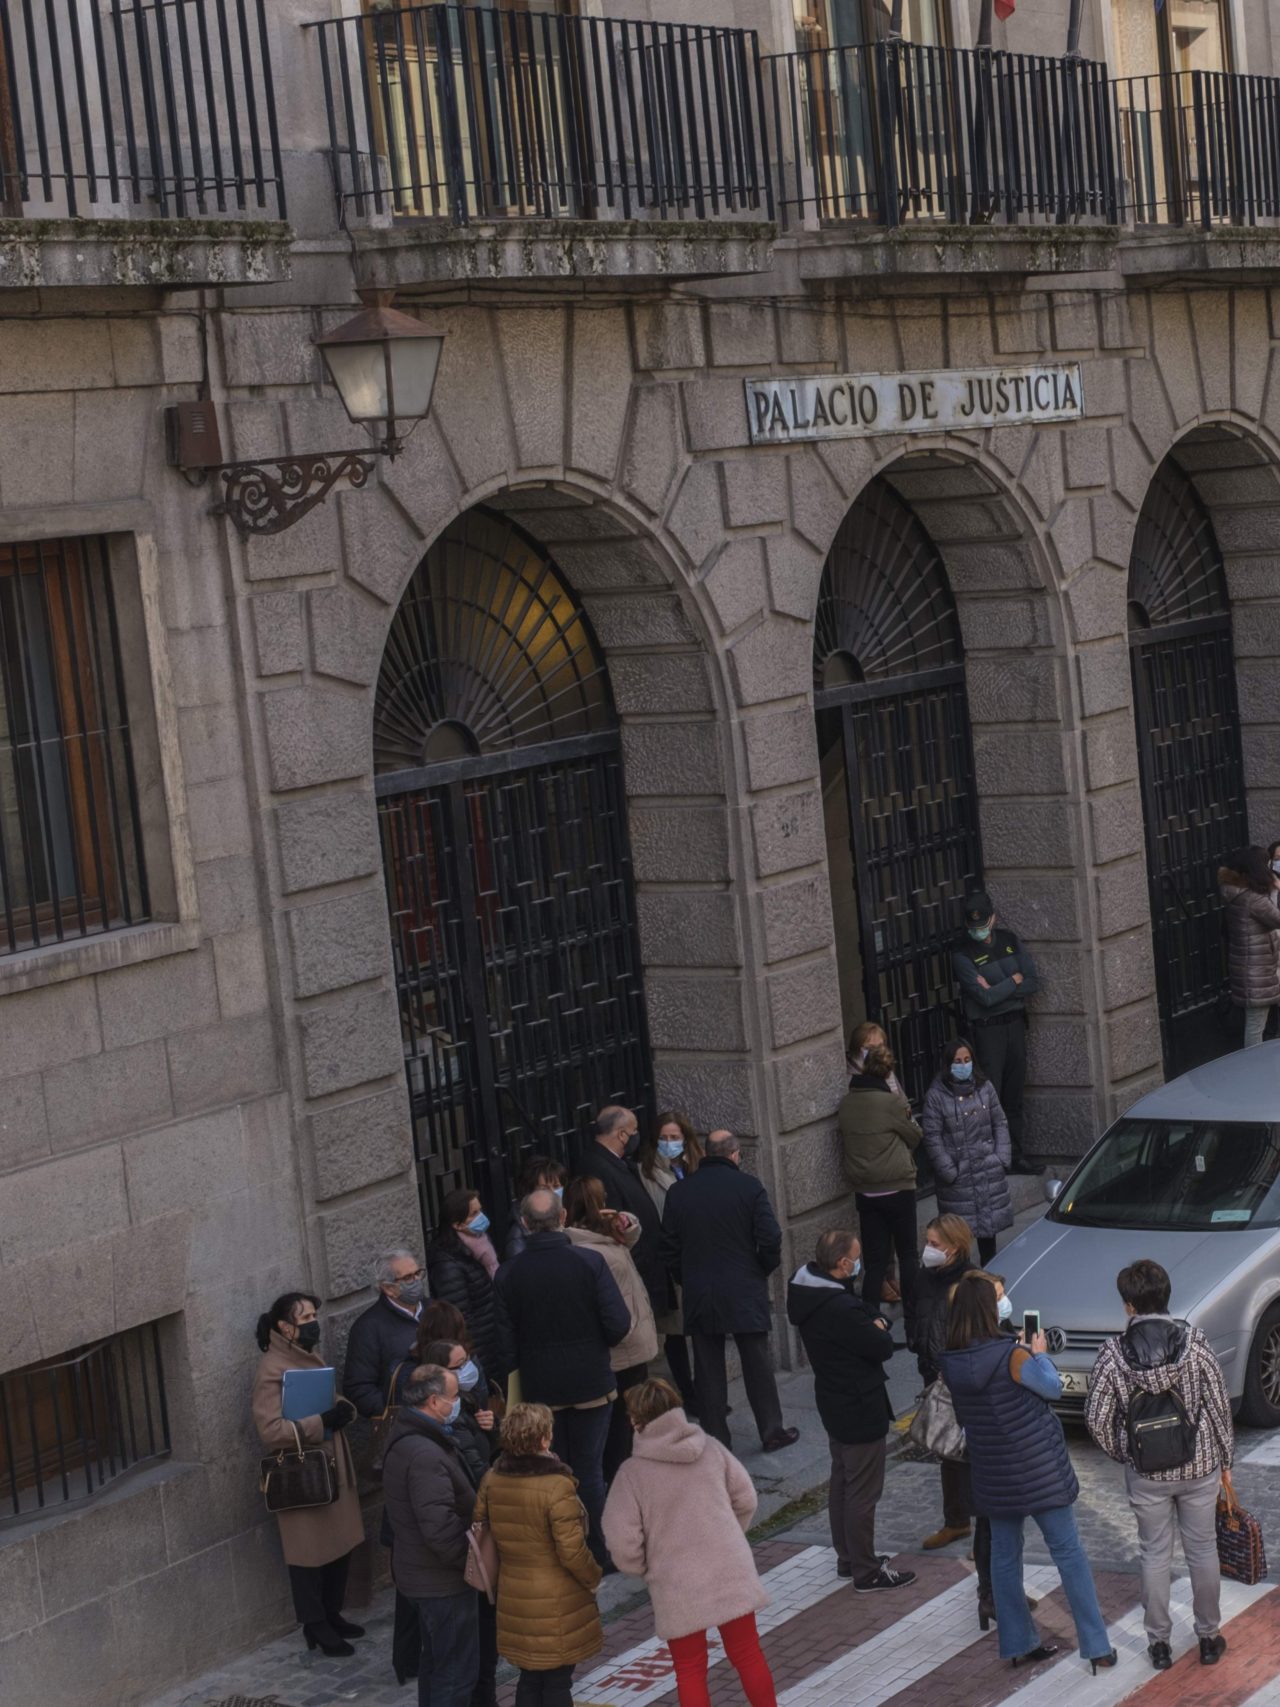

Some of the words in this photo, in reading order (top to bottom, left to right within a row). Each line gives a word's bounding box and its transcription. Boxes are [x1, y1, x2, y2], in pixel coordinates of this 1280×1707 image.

[752, 382, 878, 433] PALACIO
[898, 380, 938, 421] DE
[961, 373, 1078, 417] JUSTICIA
